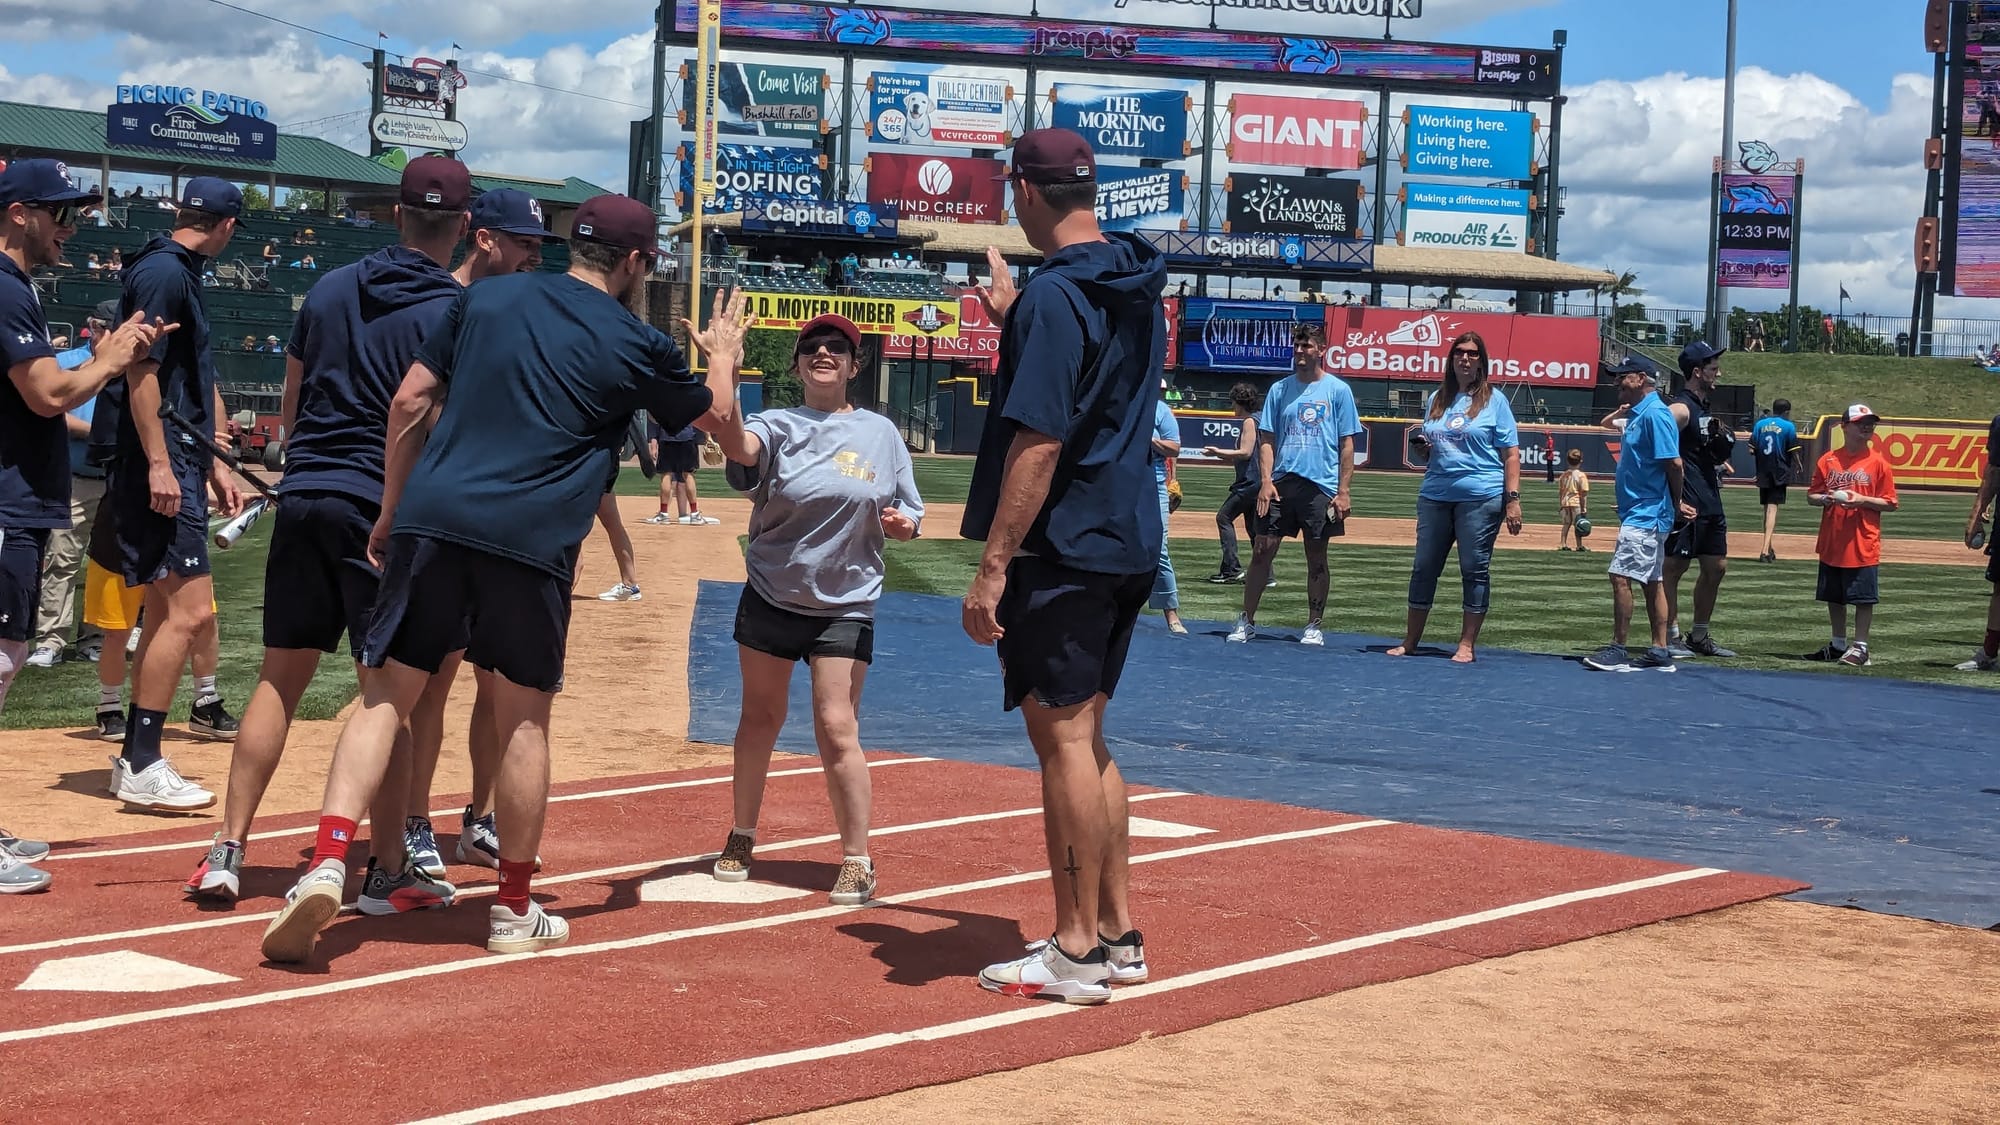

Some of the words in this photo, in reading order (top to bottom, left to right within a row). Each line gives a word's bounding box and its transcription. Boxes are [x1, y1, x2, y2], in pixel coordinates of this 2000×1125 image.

[1529, 54, 1537, 66] 0
[1528, 70, 1536, 81] 0
[1544, 63, 1551, 75] 1
[758, 70, 789, 93] Come
[793, 72, 819, 95] Visit
[878, 76, 901, 85] We're
[705, 64, 717, 116] Painting
[891, 88, 911, 96] your
[937, 80, 967, 100] VALLEY
[969, 83, 1003, 102] CENTRAL
[117, 85, 197, 105] PICNIC
[202, 90, 270, 120] PATIO
[877, 95, 895, 105] pet!
[1102, 96, 1141, 113] THE
[745, 106, 785, 120] Bushkill
[883, 115, 902, 124] 24/7
[171, 116, 197, 130] First
[391, 120, 413, 131] Lehigh
[414, 122, 433, 132] Valley
[883, 124, 902, 133] 365
[1078, 111, 1166, 133] MORNING
[1418, 114, 1473, 133] Working
[1476, 117, 1508, 132] here.
[150, 123, 241, 146] Commonwealth
[940, 131, 997, 142] vcvrec.com
[1097, 130, 1145, 148] CALL
[1417, 133, 1456, 150] Living
[1458, 135, 1491, 150] here.
[735, 160, 748, 170] IN
[751, 160, 775, 172] THE
[777, 161, 812, 175] LIGHT
[1416, 152, 1458, 170] Giving
[1461, 154, 1493, 168] here.
[715, 171, 812, 195] OOFING
[1123, 173, 1170, 187] VALLEY'S
[1110, 183, 1170, 203] SOURCE
[1414, 193, 1447, 206] Making
[1448, 196, 1455, 204] a
[1455, 195, 1500, 207] difference
[1500, 197, 1523, 208] here.
[766, 202, 844, 227] Capital
[933, 202, 985, 216] CREEK
[1111, 195, 1169, 219] NEWS
[909, 214, 958, 224] BETHLEHEM
[1268, 209, 1346, 225] LANDSCAPE
[1314, 222, 1346, 232] works
[1463, 222, 1489, 235] AIR
[1724, 225, 1762, 238] 12:33
[1766, 226, 1791, 239] PM
[1412, 231, 1488, 247] PRODUCTS
[1206, 236, 1276, 259] Capital
[1210, 317, 1249, 345] SCOTT
[1253, 318, 1294, 348] PAYNE
[1346, 330, 1384, 348] Let's
[1215, 346, 1246, 357] CUSTOM
[1248, 347, 1271, 358] POOLS
[1326, 345, 1590, 380] GoBachns.com
[1763, 435, 1774, 455] 3
